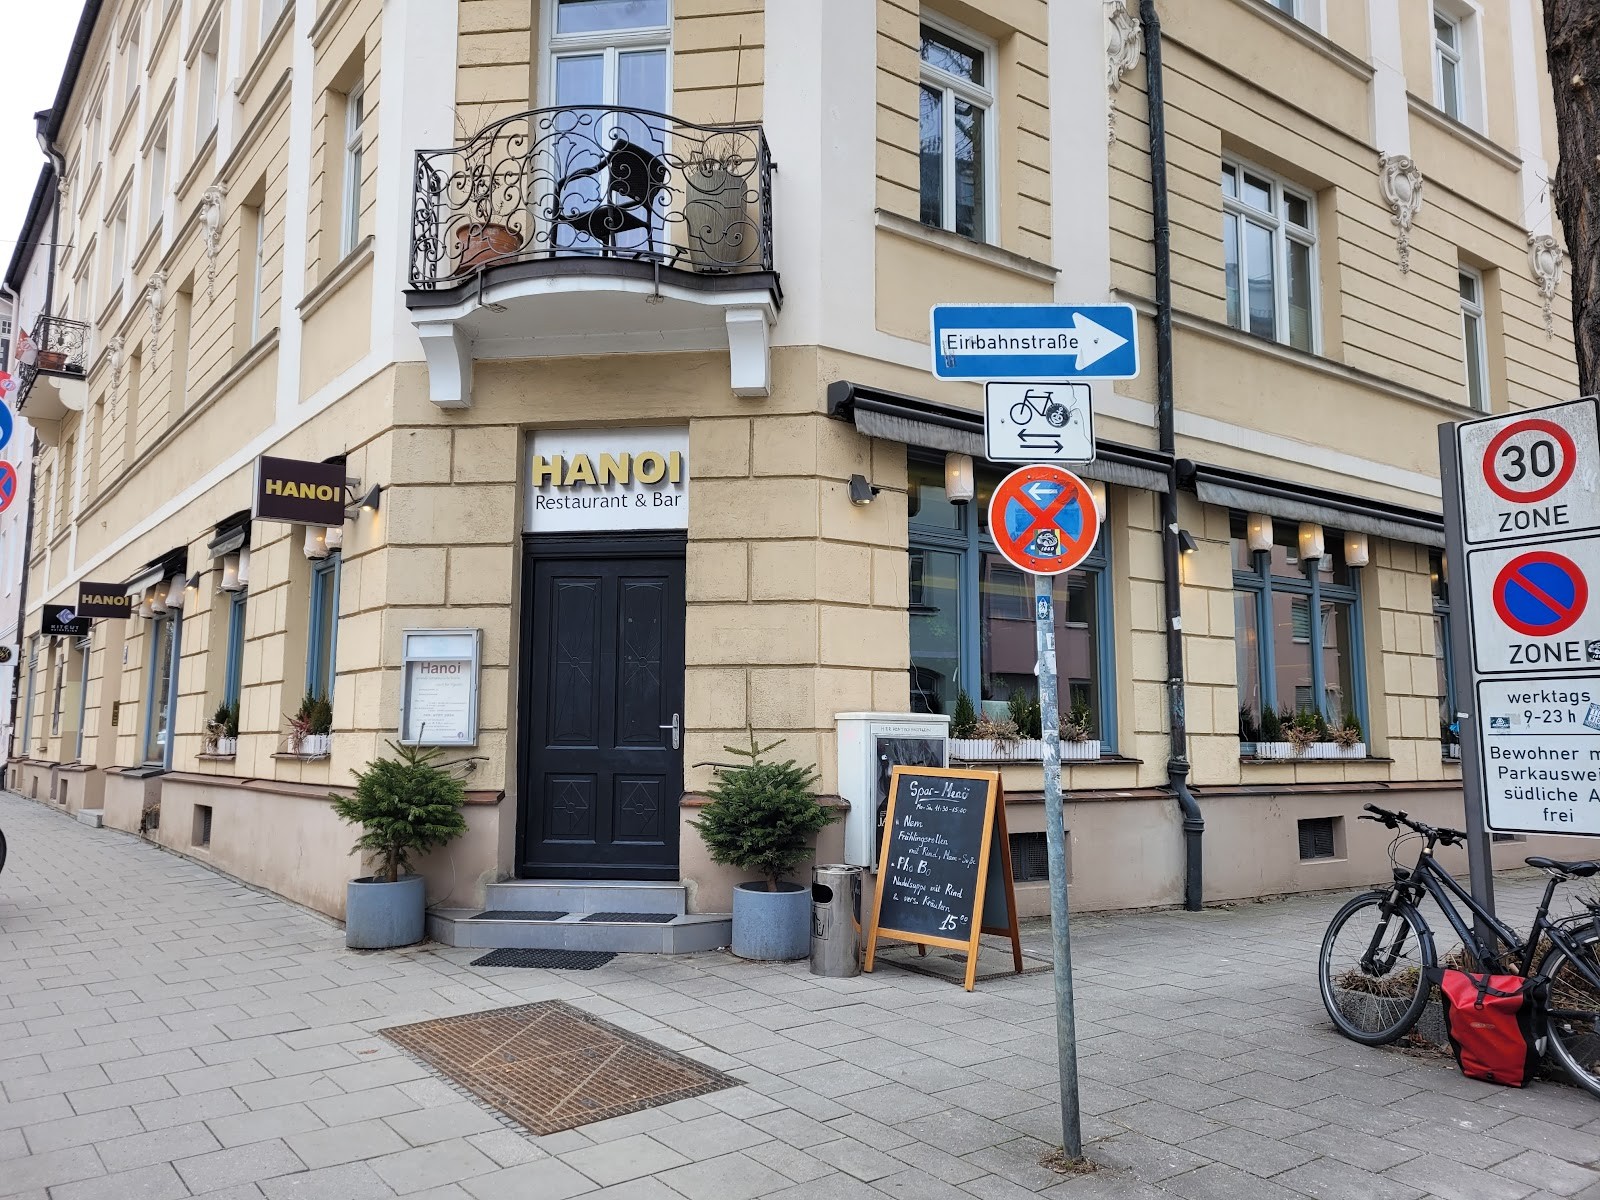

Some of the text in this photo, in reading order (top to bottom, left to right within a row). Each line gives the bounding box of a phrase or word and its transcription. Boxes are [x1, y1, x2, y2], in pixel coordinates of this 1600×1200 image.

[946, 333, 1079, 350] Einbahnstraße
[531, 451, 682, 487] HANOI
[1501, 440, 1555, 482] 30
[265, 478, 340, 502] HANOI
[535, 491, 682, 510] Restaurant & Bar
[1498, 504, 1570, 532] ZONE
[81, 594, 129, 606] HANOI
[1508, 641, 1581, 664] ZONE
[420, 661, 461, 674] Hanoi
[1507, 689, 1591, 706] werktags
[1524, 709, 1563, 723] 9-23
[1568, 709, 1576, 723] h
[1490, 746, 1579, 760] Bewohner
[1504, 786, 1600, 803] südliche A
[903, 814, 924, 828] Nem
[1543, 807, 1574, 822] frei
[896, 856, 932, 877] Pho Bo
[929, 884, 941, 893] mit
[945, 883, 964, 899] Rind
